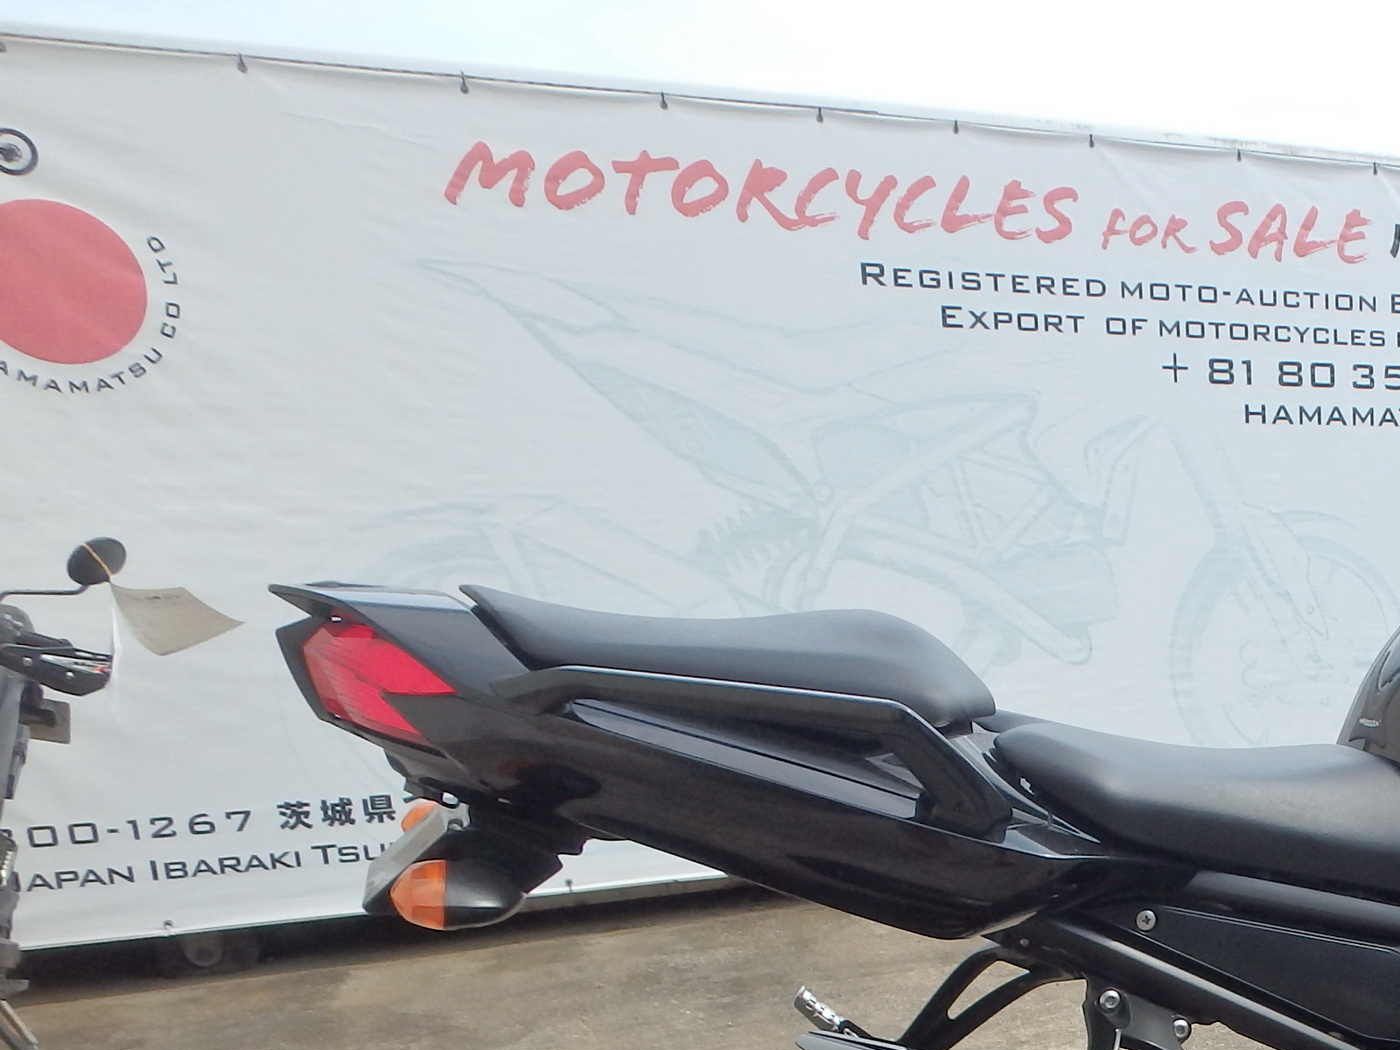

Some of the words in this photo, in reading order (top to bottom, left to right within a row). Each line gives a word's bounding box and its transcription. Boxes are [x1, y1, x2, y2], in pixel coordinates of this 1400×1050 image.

[444, 141, 1079, 244] MOTORCYCLES
[1208, 200, 1373, 264] SALE
[147, 236, 178, 285] LTD
[860, 262, 1107, 298] REGISTERED
[1120, 280, 1378, 313] MOTO-AUCTION
[160, 302, 181, 338] CO
[940, 305, 1085, 333] EXPORT
[1105, 317, 1148, 336] OF
[1159, 320, 1386, 347] MOTORCYCLES
[1208, 358, 1253, 385] 81
[1277, 361, 1336, 388] 80
[149, 850, 303, 881] IBARAKI
[311, 842, 396, 865] TSU
